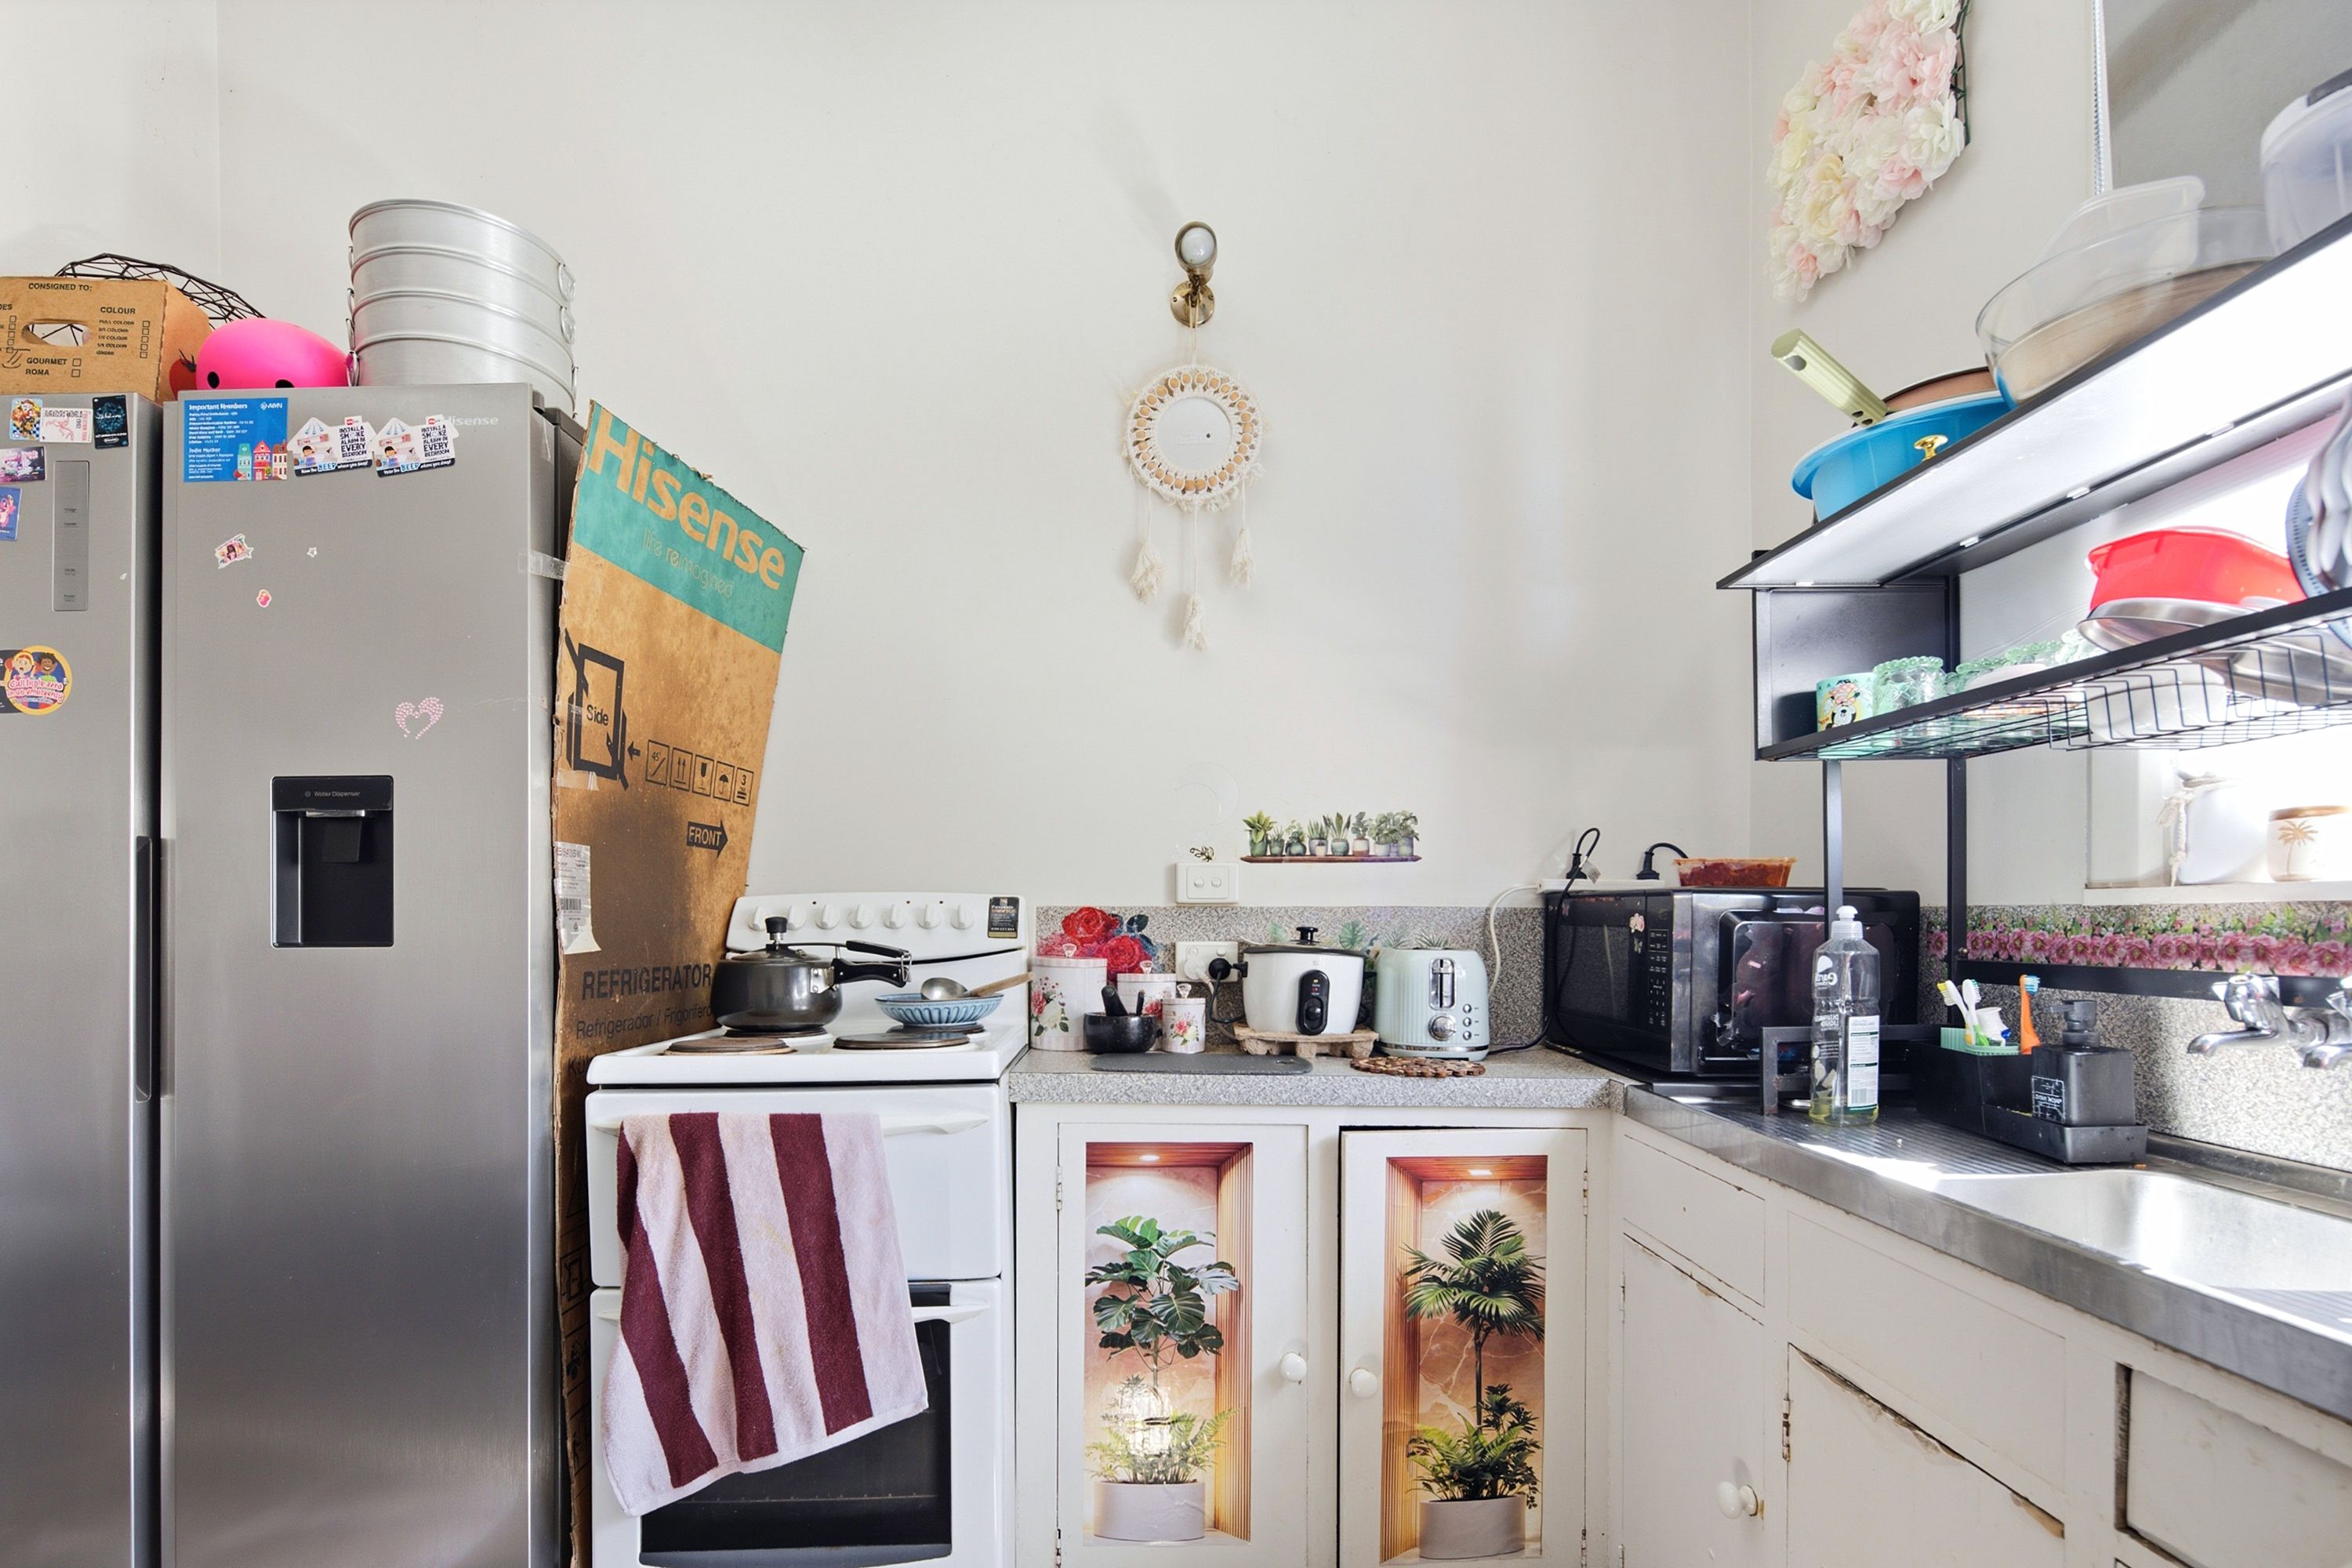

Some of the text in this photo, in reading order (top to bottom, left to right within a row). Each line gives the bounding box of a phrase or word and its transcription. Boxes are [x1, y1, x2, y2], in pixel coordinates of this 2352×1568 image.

[26, 357, 67, 365] GOURMET
[341, 442, 366, 453] EVERY
[423, 441, 448, 452] EVERY
[318, 462, 337, 471] BEEP
[401, 463, 419, 471] BEEP
[588, 407, 785, 590] Hisense
[642, 527, 735, 598] life reimagined
[9, 680, 25, 689] Call
[586, 704, 608, 727] Side
[741, 774, 747, 786] 3
[688, 826, 721, 847] FRONT
[582, 964, 711, 1000] REFRIGERATOR
[576, 1011, 654, 1040] Refrigerador
